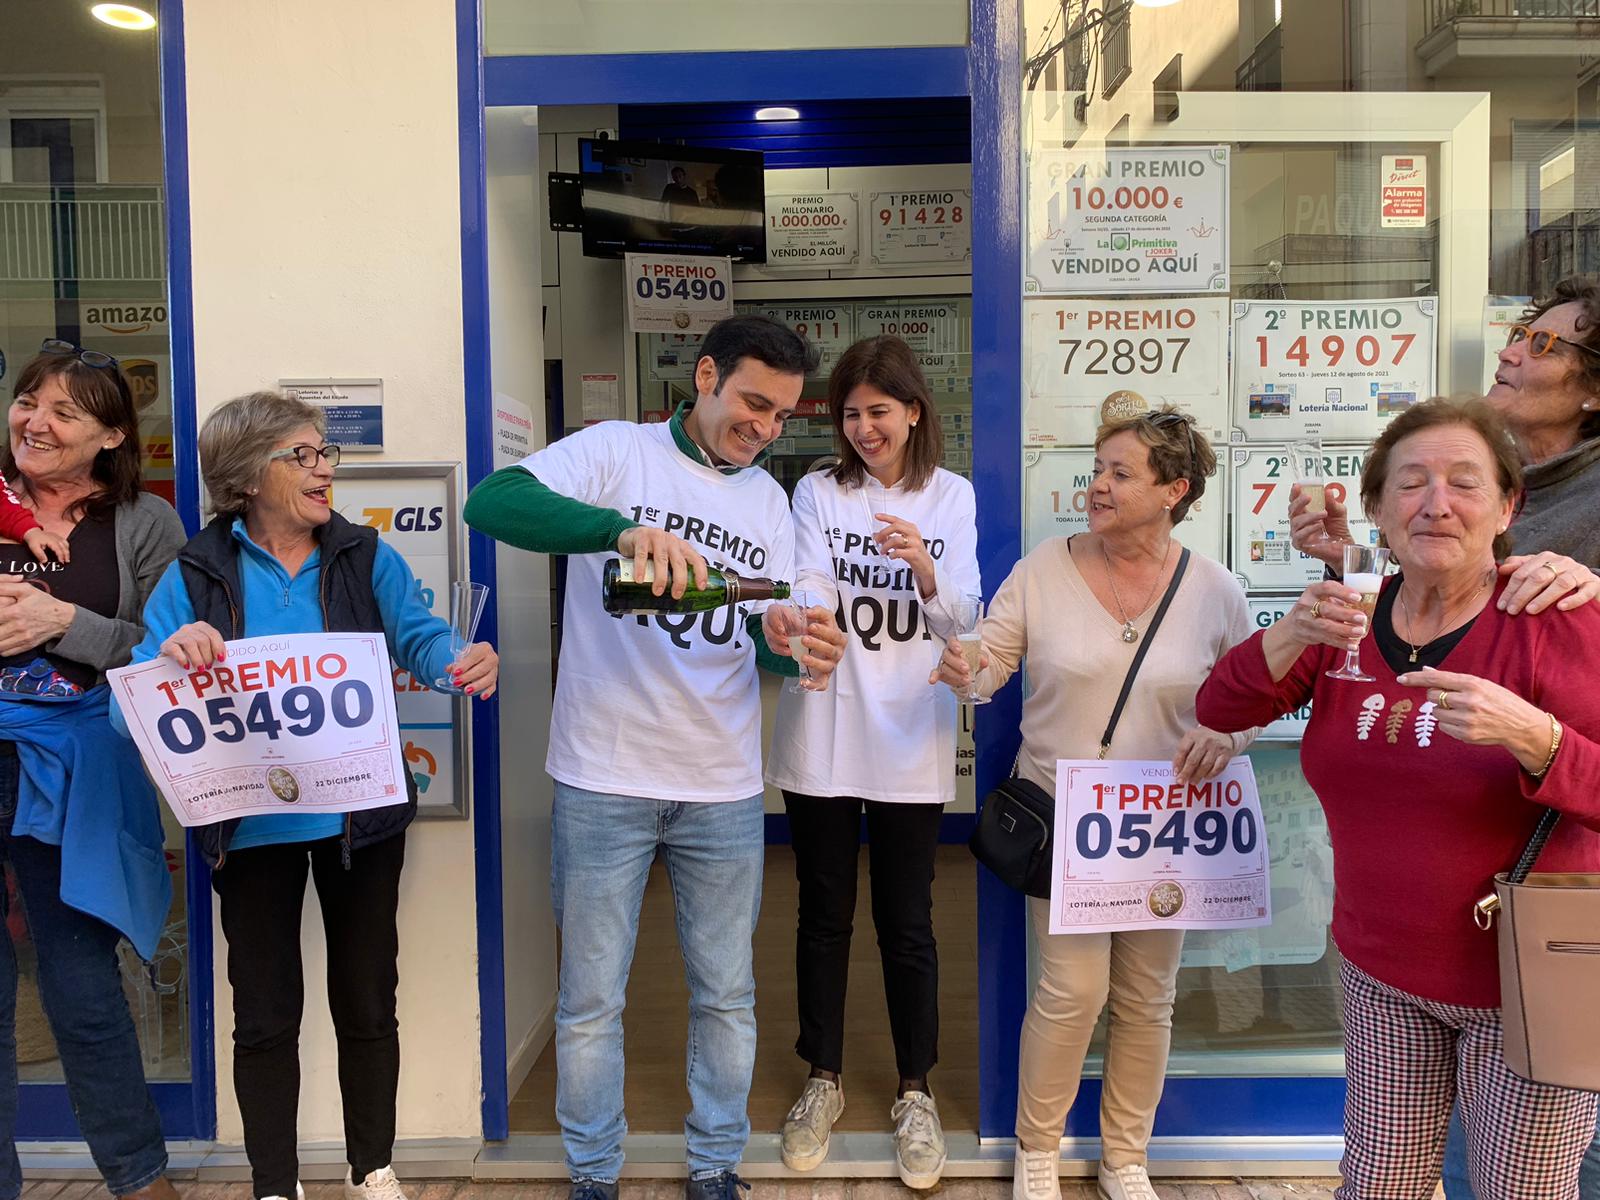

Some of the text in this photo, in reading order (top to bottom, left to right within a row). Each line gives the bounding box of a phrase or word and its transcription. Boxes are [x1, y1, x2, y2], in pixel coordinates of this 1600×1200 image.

[1048, 160, 1205, 178] GRAN PREMIO
[902, 193, 954, 206] PREMIO
[1073, 186, 1184, 210] 10.000 €
[1385, 188, 1422, 197] Alarma
[782, 206, 834, 214] MILLONARIO
[880, 206, 963, 226] 91428
[770, 214, 840, 228] 1.000.000
[1084, 214, 1167, 224] SEGUNDA CATEGORÍA
[771, 244, 845, 257] VENDIDO AQUÍ
[1097, 238, 1178, 248] La Primitiva
[654, 264, 716, 278] PREMIO
[1052, 253, 1198, 274] VENDIDO AQUÍ
[636, 277, 726, 301] 05490
[87, 306, 166, 324] amazo
[786, 310, 836, 321] PREMIO
[868, 308, 946, 320] GRAN PREMIO
[1056, 308, 1196, 330] 1er PREMIO
[1301, 308, 1402, 330] PREMIO
[880, 322, 929, 334] 10.000
[1058, 338, 1190, 374] 72897
[1256, 334, 1416, 368] 14907
[919, 354, 944, 366] AQUÍ
[132, 376, 156, 394] ps
[1299, 403, 1368, 412] Lotería Nacional
[394, 506, 443, 532] GLS
[664, 511, 766, 570] PREMIO
[10, 560, 64, 572] LOVE
[260, 641, 290, 654] AQUÍ
[156, 654, 348, 706] 1er PREMIO
[157, 680, 374, 754] 05490
[326, 772, 372, 786] DICIEMBRE
[188, 788, 224, 804] LOTERÍA
[232, 784, 264, 792] NAVIDAD
[1092, 780, 1242, 810] 1er PREMIO
[1076, 808, 1256, 860] 05490
[1070, 900, 1100, 908] LOTERÍA
[1110, 898, 1142, 907] NAVIDAD
[1214, 896, 1252, 904] DICIEMBRE
